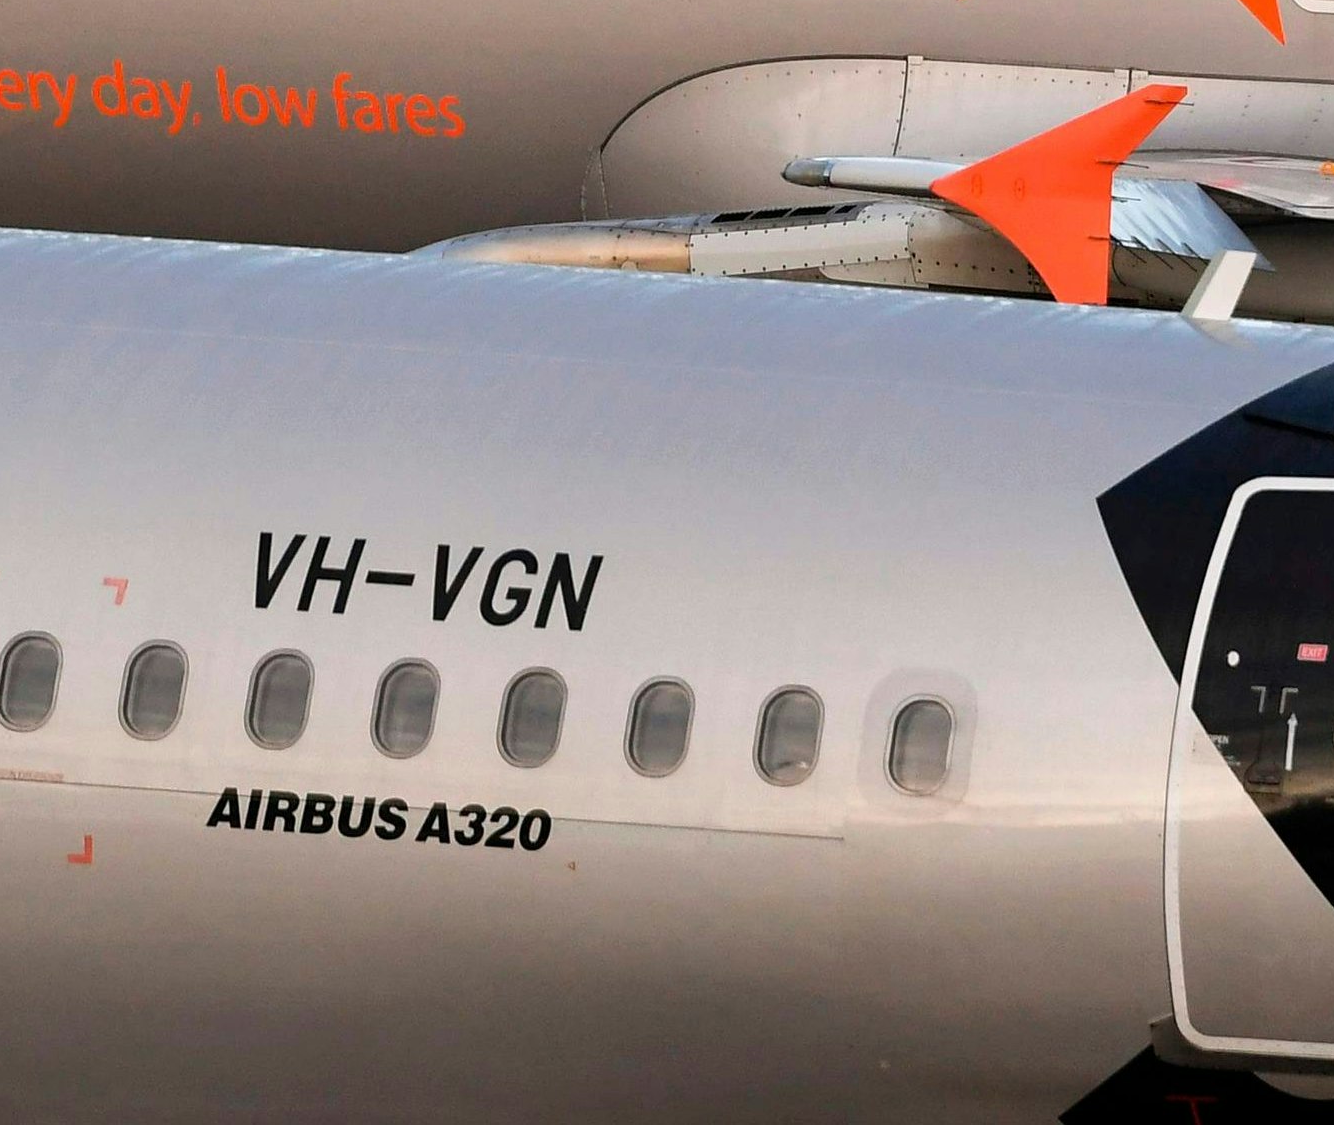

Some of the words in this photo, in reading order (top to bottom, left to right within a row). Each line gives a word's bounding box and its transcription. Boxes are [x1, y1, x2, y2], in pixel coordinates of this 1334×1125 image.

[91, 58, 201, 135] day,
[215, 65, 318, 128] low
[331, 71, 466, 138] fares
[253, 531, 604, 632] VH-VGN
[1299, 644, 1325, 659] EXIT
[206, 787, 408, 842] AIRBUS
[415, 804, 553, 852] A320
